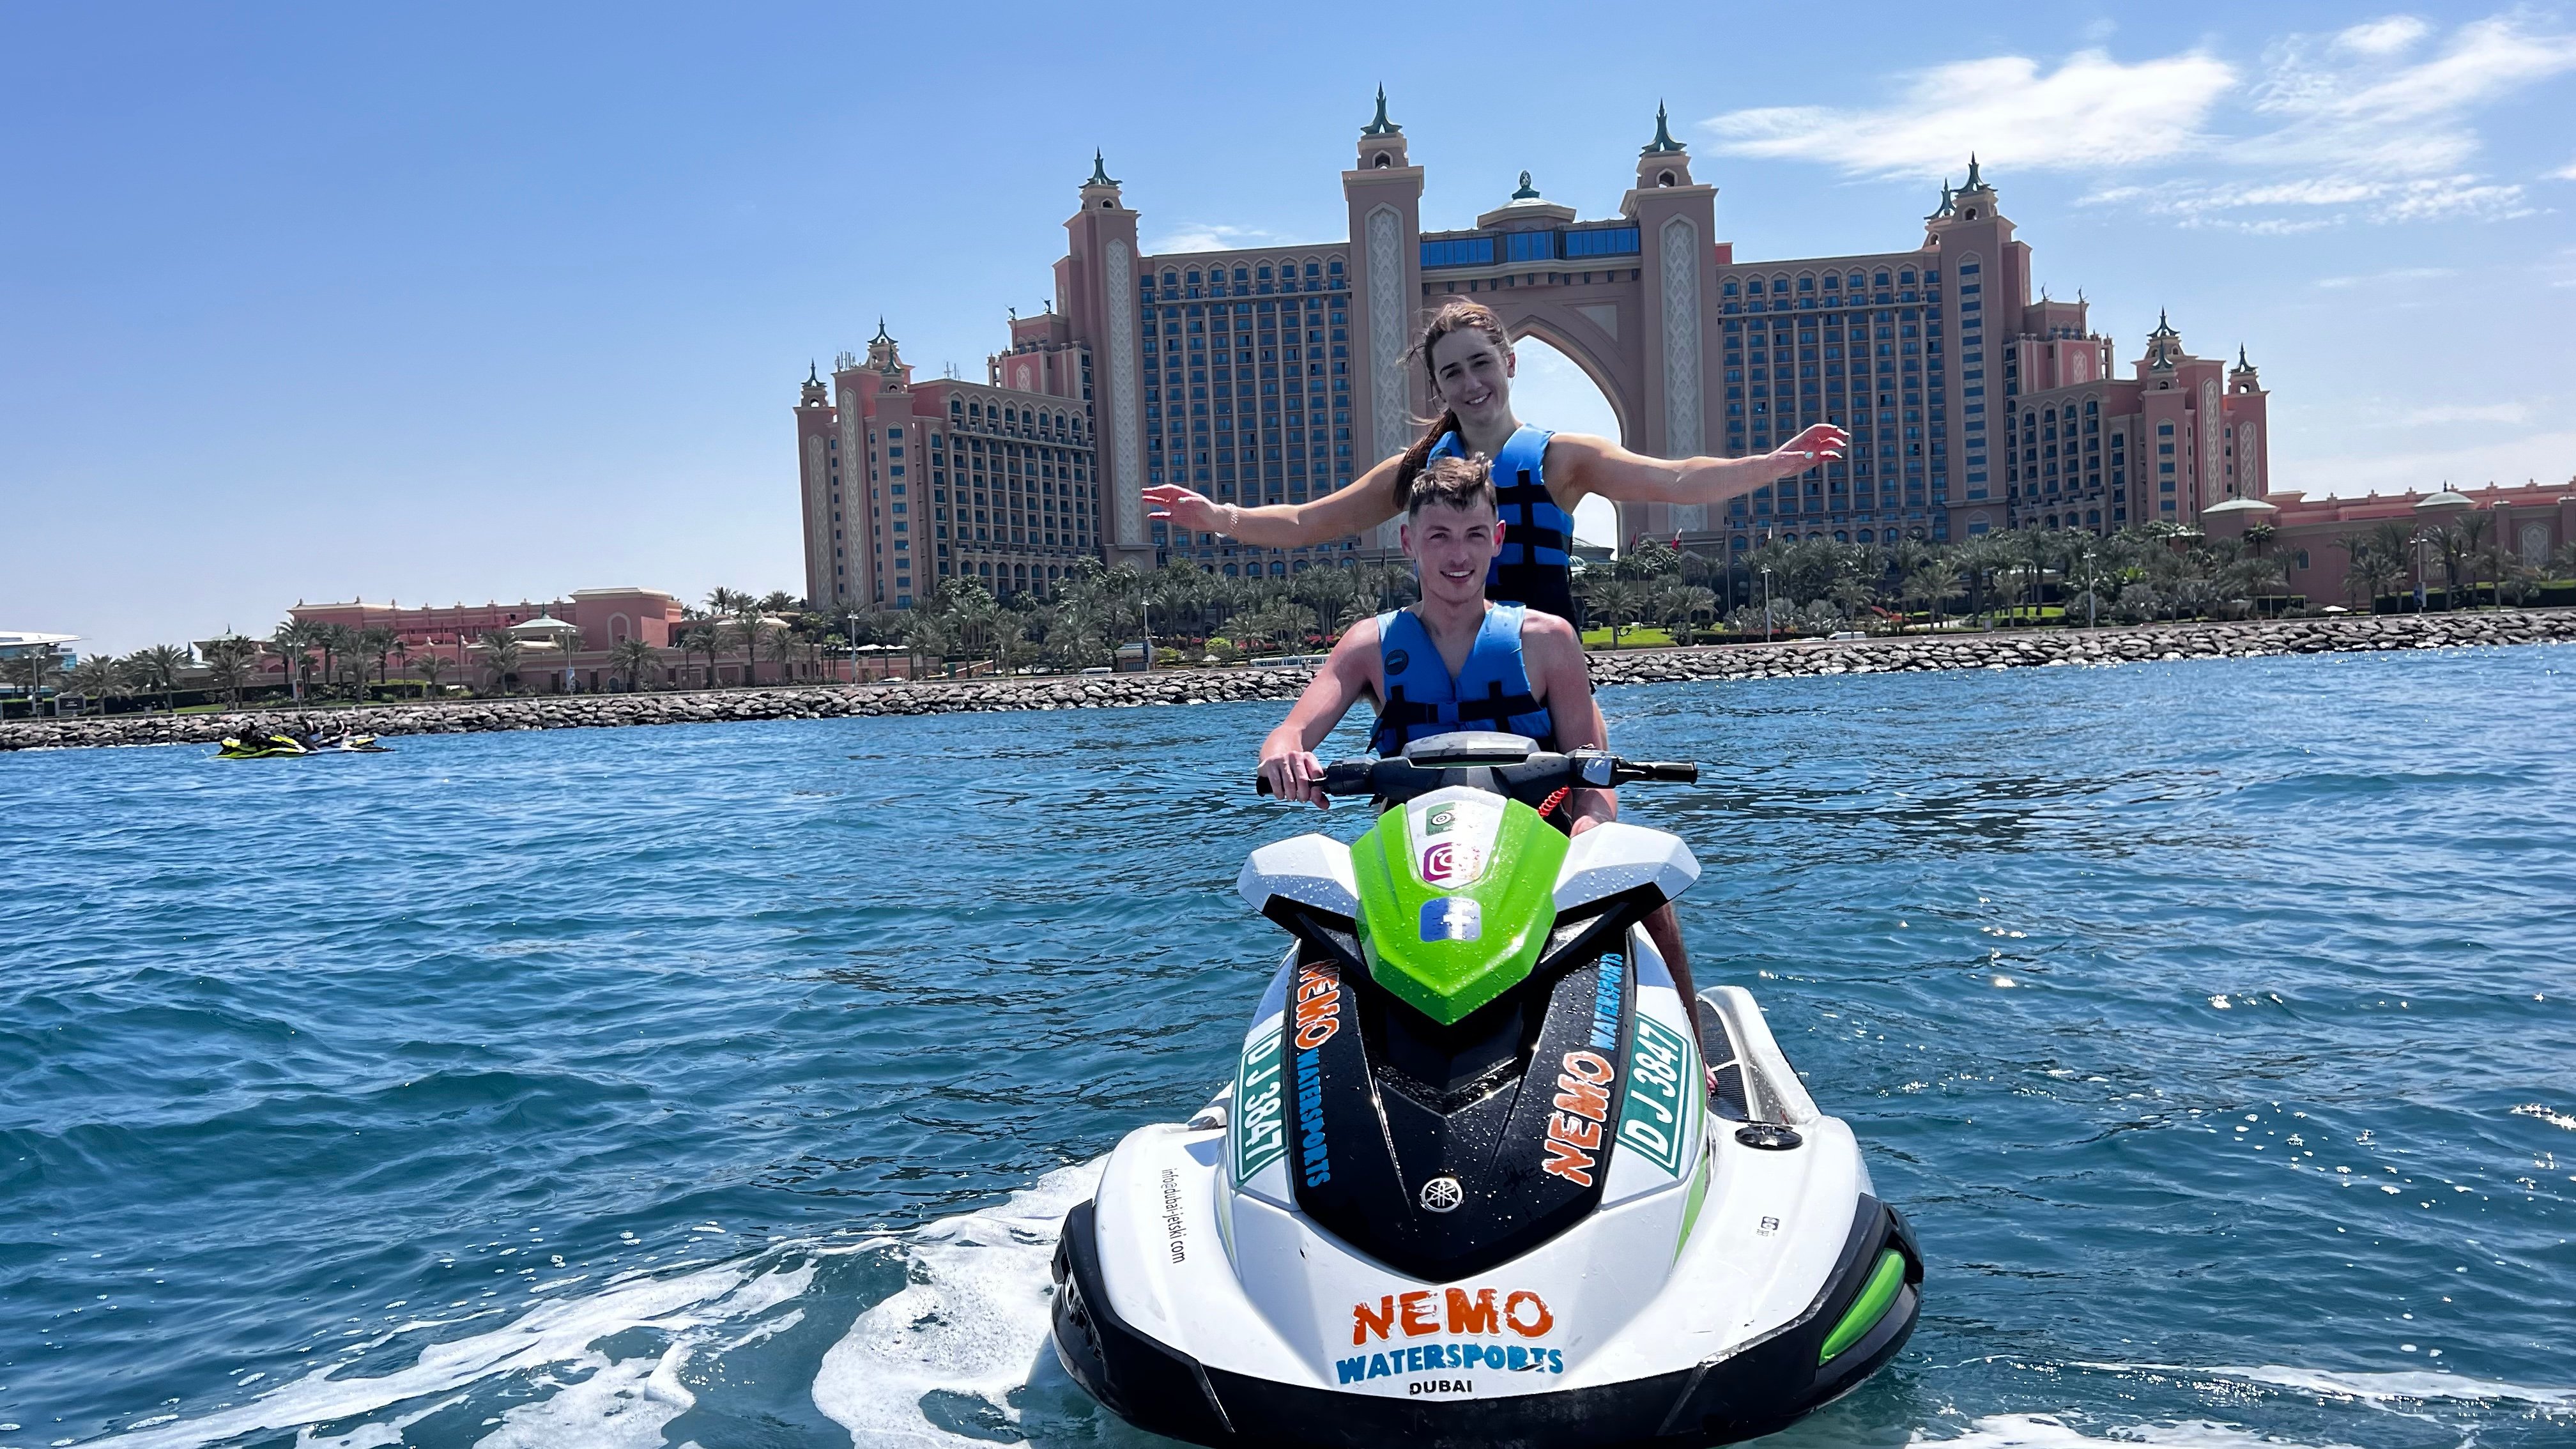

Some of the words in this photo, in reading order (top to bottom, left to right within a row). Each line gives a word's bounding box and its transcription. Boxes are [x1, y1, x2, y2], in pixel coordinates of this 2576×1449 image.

[1295, 959, 1340, 1050] NEMO
[1247, 1033, 1282, 1066] D
[1542, 1050, 1614, 1187] NEMO
[1590, 953, 1623, 1051] WATERSPORTS
[1633, 1021, 1679, 1097] 3847
[1245, 1066, 1280, 1087] J
[1245, 1083, 1283, 1161] 3847
[1296, 1048, 1330, 1187] WATERSPORTS
[1630, 1091, 1673, 1124] J
[1624, 1119, 1669, 1156] D
[1351, 1287, 1554, 1347] NEMO
[1336, 1343, 1563, 1384] WATERSPORTS
[1409, 1379, 1473, 1395] DUBAI
